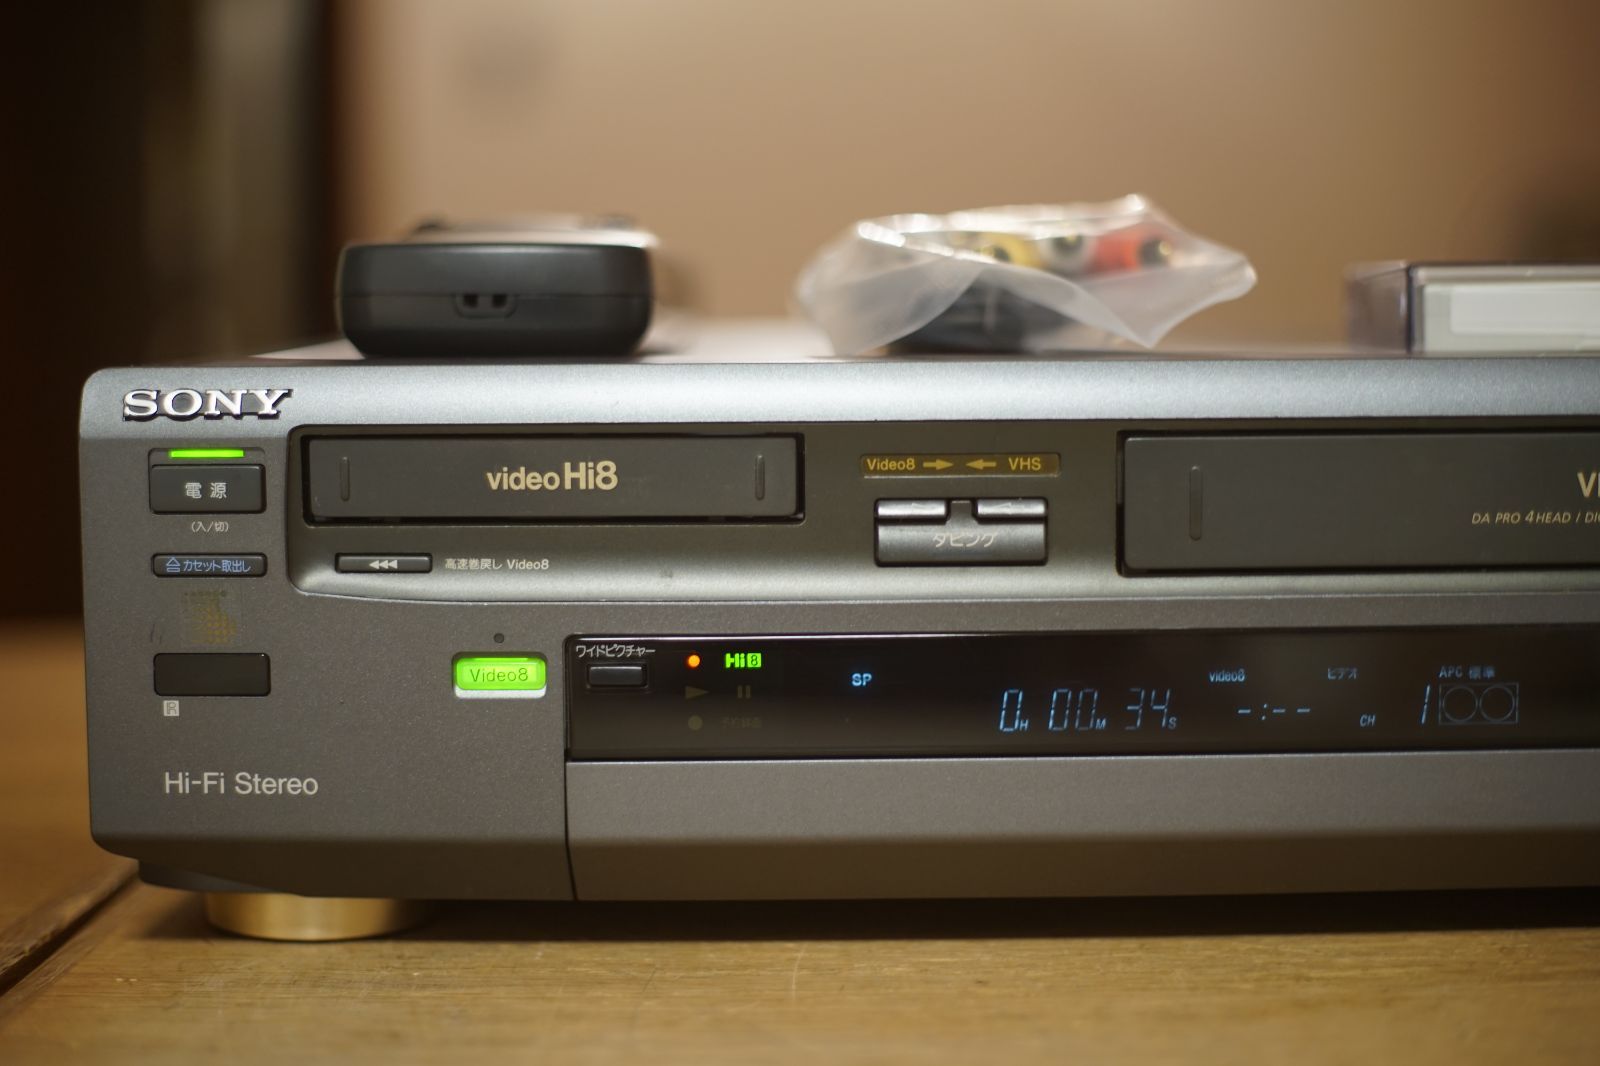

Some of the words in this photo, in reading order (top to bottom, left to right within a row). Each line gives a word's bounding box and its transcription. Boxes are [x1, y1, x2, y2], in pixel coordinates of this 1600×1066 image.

[123, 388, 292, 421] SONY
[866, 457, 916, 471] Video8
[1008, 457, 1042, 471] VHS
[486, 466, 560, 490] video
[564, 460, 619, 490] Hi8
[185, 481, 228, 499] 電源
[1577, 471, 1600, 498] V
[1471, 512, 1491, 525] DA
[1495, 512, 1521, 524] PRO
[933, 530, 998, 548] ダビング
[182, 558, 251, 573] カセット取出し
[445, 558, 502, 570] 高速巻戻し
[506, 558, 549, 570] Video8
[575, 644, 656, 658] ワイドピクチャー
[725, 652, 762, 669] Hi8
[469, 667, 530, 683] Video8
[851, 672, 873, 687] SP
[1209, 669, 1246, 683] video8
[1438, 665, 1463, 679] APC
[1359, 713, 1376, 728] CH
[164, 771, 226, 794] Hi-Fi
[235, 771, 319, 795] Stereo
